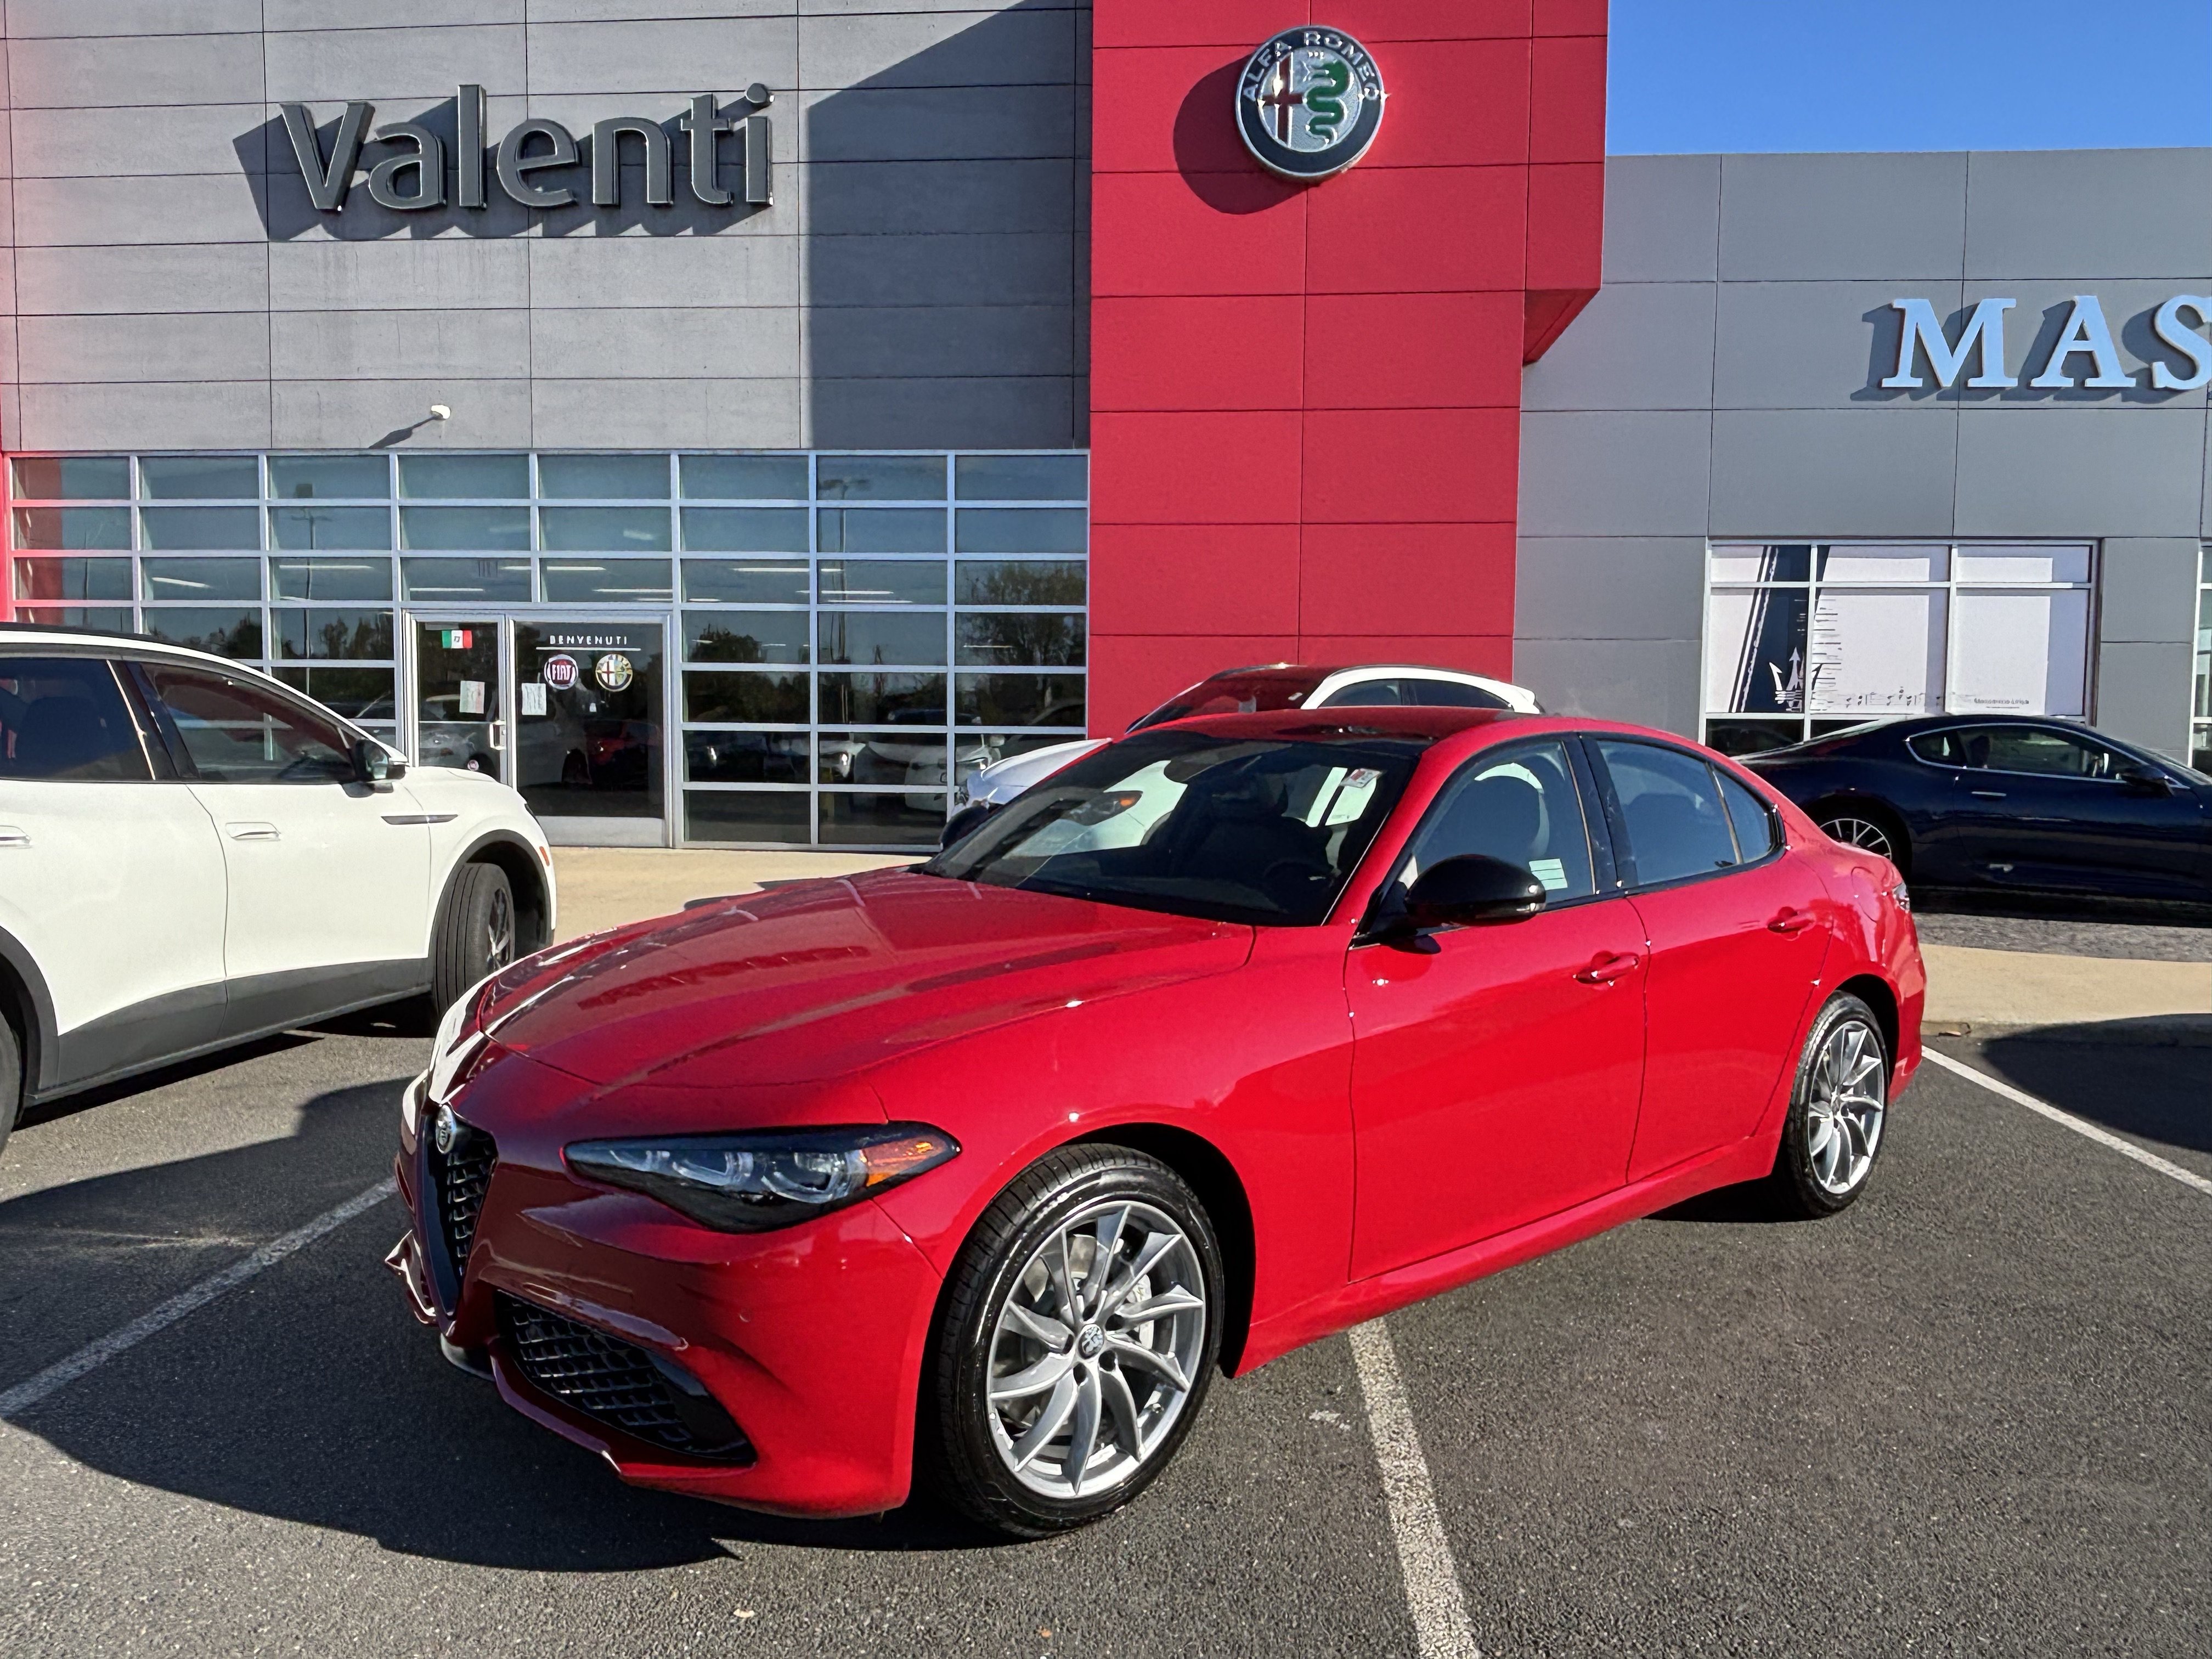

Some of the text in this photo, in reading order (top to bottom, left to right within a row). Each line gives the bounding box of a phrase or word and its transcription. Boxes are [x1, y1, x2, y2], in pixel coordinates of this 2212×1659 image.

[1243, 31, 1380, 102] ALFA ROMEO
[279, 82, 775, 214] Valenti
[550, 635, 628, 645] BENVENUTI
[552, 664, 572, 680] FIAT
